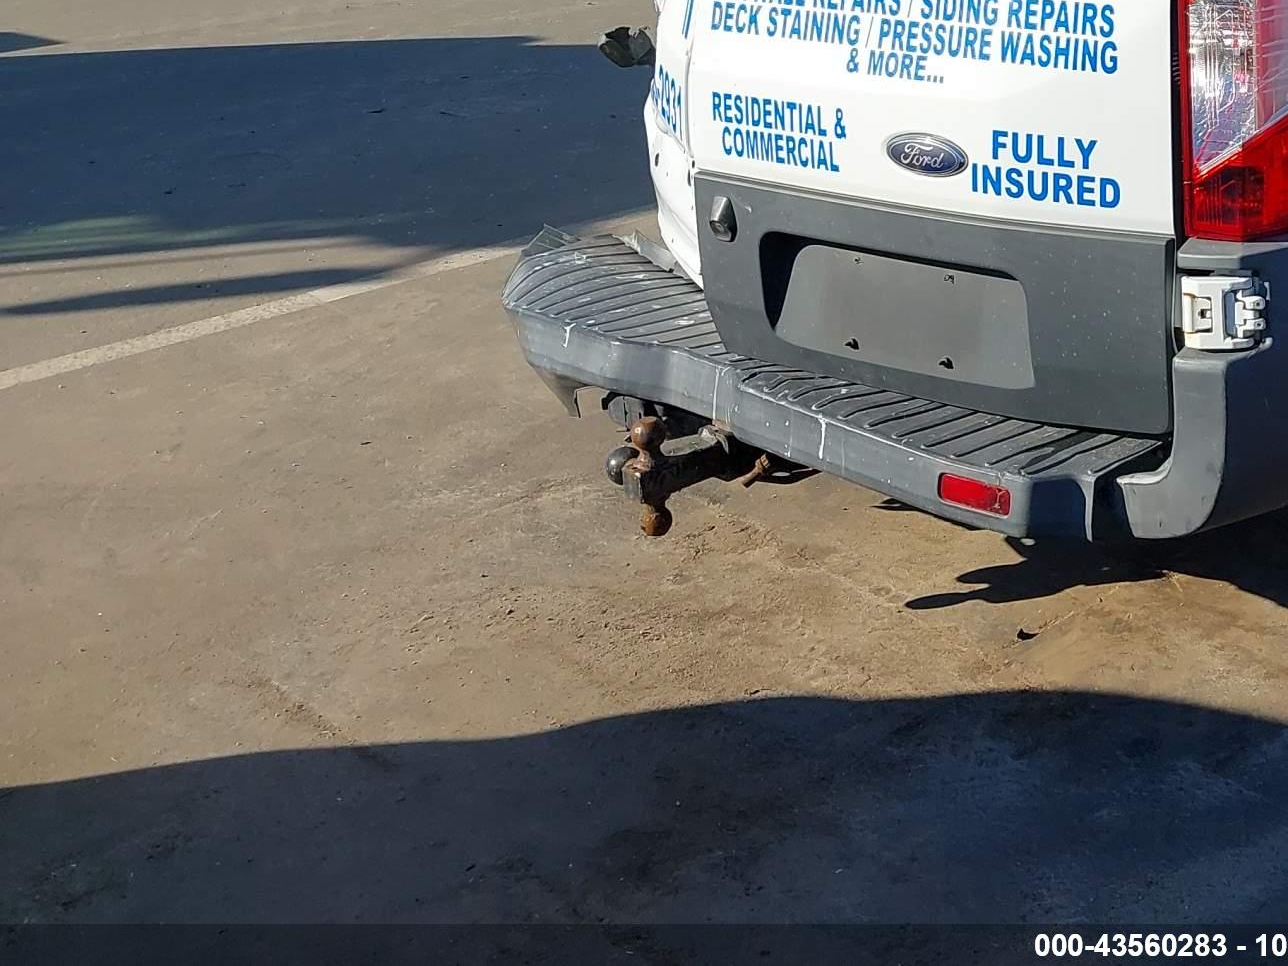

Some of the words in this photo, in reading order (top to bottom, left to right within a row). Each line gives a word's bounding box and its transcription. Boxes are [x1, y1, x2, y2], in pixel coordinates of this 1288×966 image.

[711, 2, 762, 35] DECK
[768, 8, 861, 46] STAINING
[876, 18, 992, 61] PRESSURE
[1000, 28, 1118, 75] WASHING
[846, 47, 860, 74] &
[867, 49, 945, 84] MORE...
[711, 91, 827, 138] RESIDENTIAL
[834, 108, 847, 140] &
[721, 128, 841, 172] COMMERCIAL
[899, 138, 945, 171] Ford
[991, 130, 1098, 170] FULLY
[971, 163, 1121, 209] INSURED
